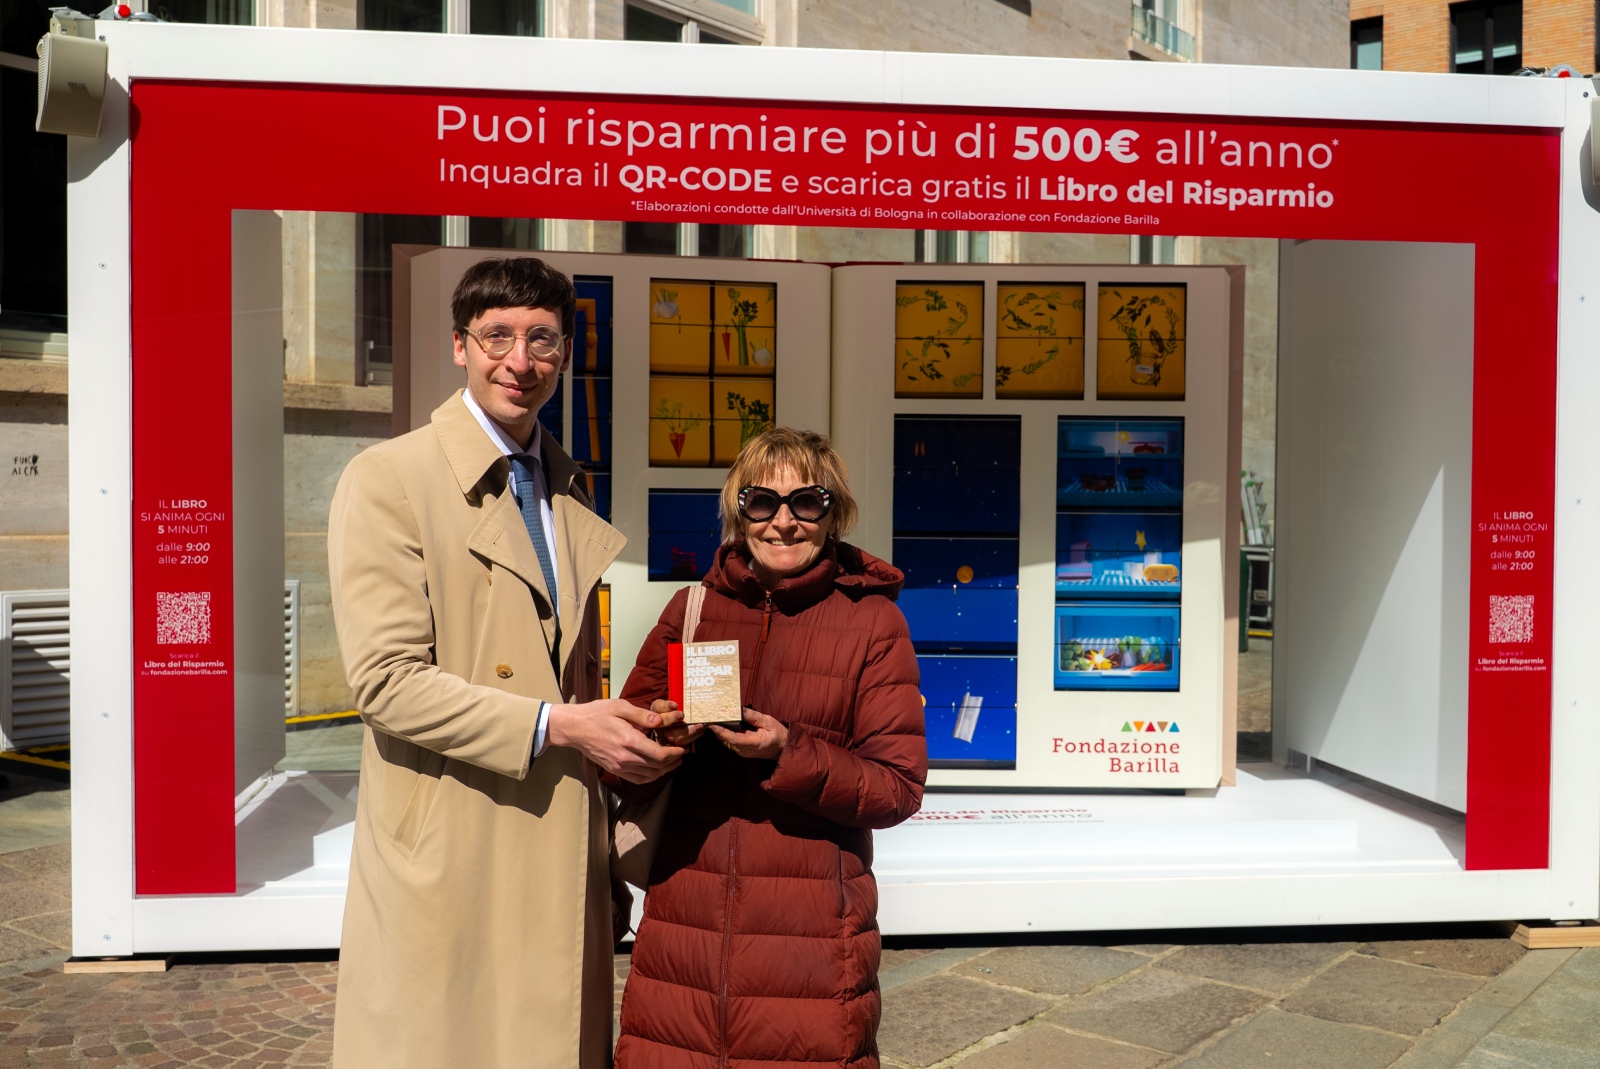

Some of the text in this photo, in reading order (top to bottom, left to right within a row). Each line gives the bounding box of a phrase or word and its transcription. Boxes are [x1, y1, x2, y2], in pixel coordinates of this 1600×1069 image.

[437, 104, 546, 144] Puoi
[567, 107, 847, 156] risparmiare
[865, 119, 936, 164] più
[955, 122, 996, 159] di
[1012, 125, 1140, 164] 500€
[440, 158, 1334, 211] Inquadra il QR-CODE e scarica gratis il Libro del Risparmio
[714, 204, 769, 215] condotte
[772, 204, 857, 217] dall'Università
[859, 207, 871, 217] di
[874, 207, 924, 221] Bologna
[927, 210, 938, 219] in
[941, 209, 1027, 222] collaborazione
[1029, 214, 1051, 222] con
[1054, 212, 1121, 224] Fondazione
[1124, 214, 1160, 225] Barilla
[159, 499, 207, 509] IL LIBRO
[140, 512, 225, 521] SI ANIMA OGNI
[1493, 511, 1534, 520] IL LIBRO
[157, 525, 208, 534] 5 MINUTI
[1478, 523, 1548, 532] SI ANIMA OGNI
[1492, 534, 1534, 543] 5 MINUTI
[156, 542, 211, 552] dalle 9:00
[1490, 550, 1536, 559] dalle 9:00
[158, 555, 209, 565] alle 21:00
[1491, 562, 1534, 571] alle 21:00
[686, 645, 736, 656] IL LIBRO
[182, 660, 225, 669] Risparmio
[686, 657, 709, 666] DEL
[1509, 657, 1544, 666] Risparmio
[687, 665, 733, 677] RISPAR
[687, 676, 715, 687] MIO
[1052, 738, 1180, 754] Fondazione
[1109, 757, 1180, 773] Barilla
